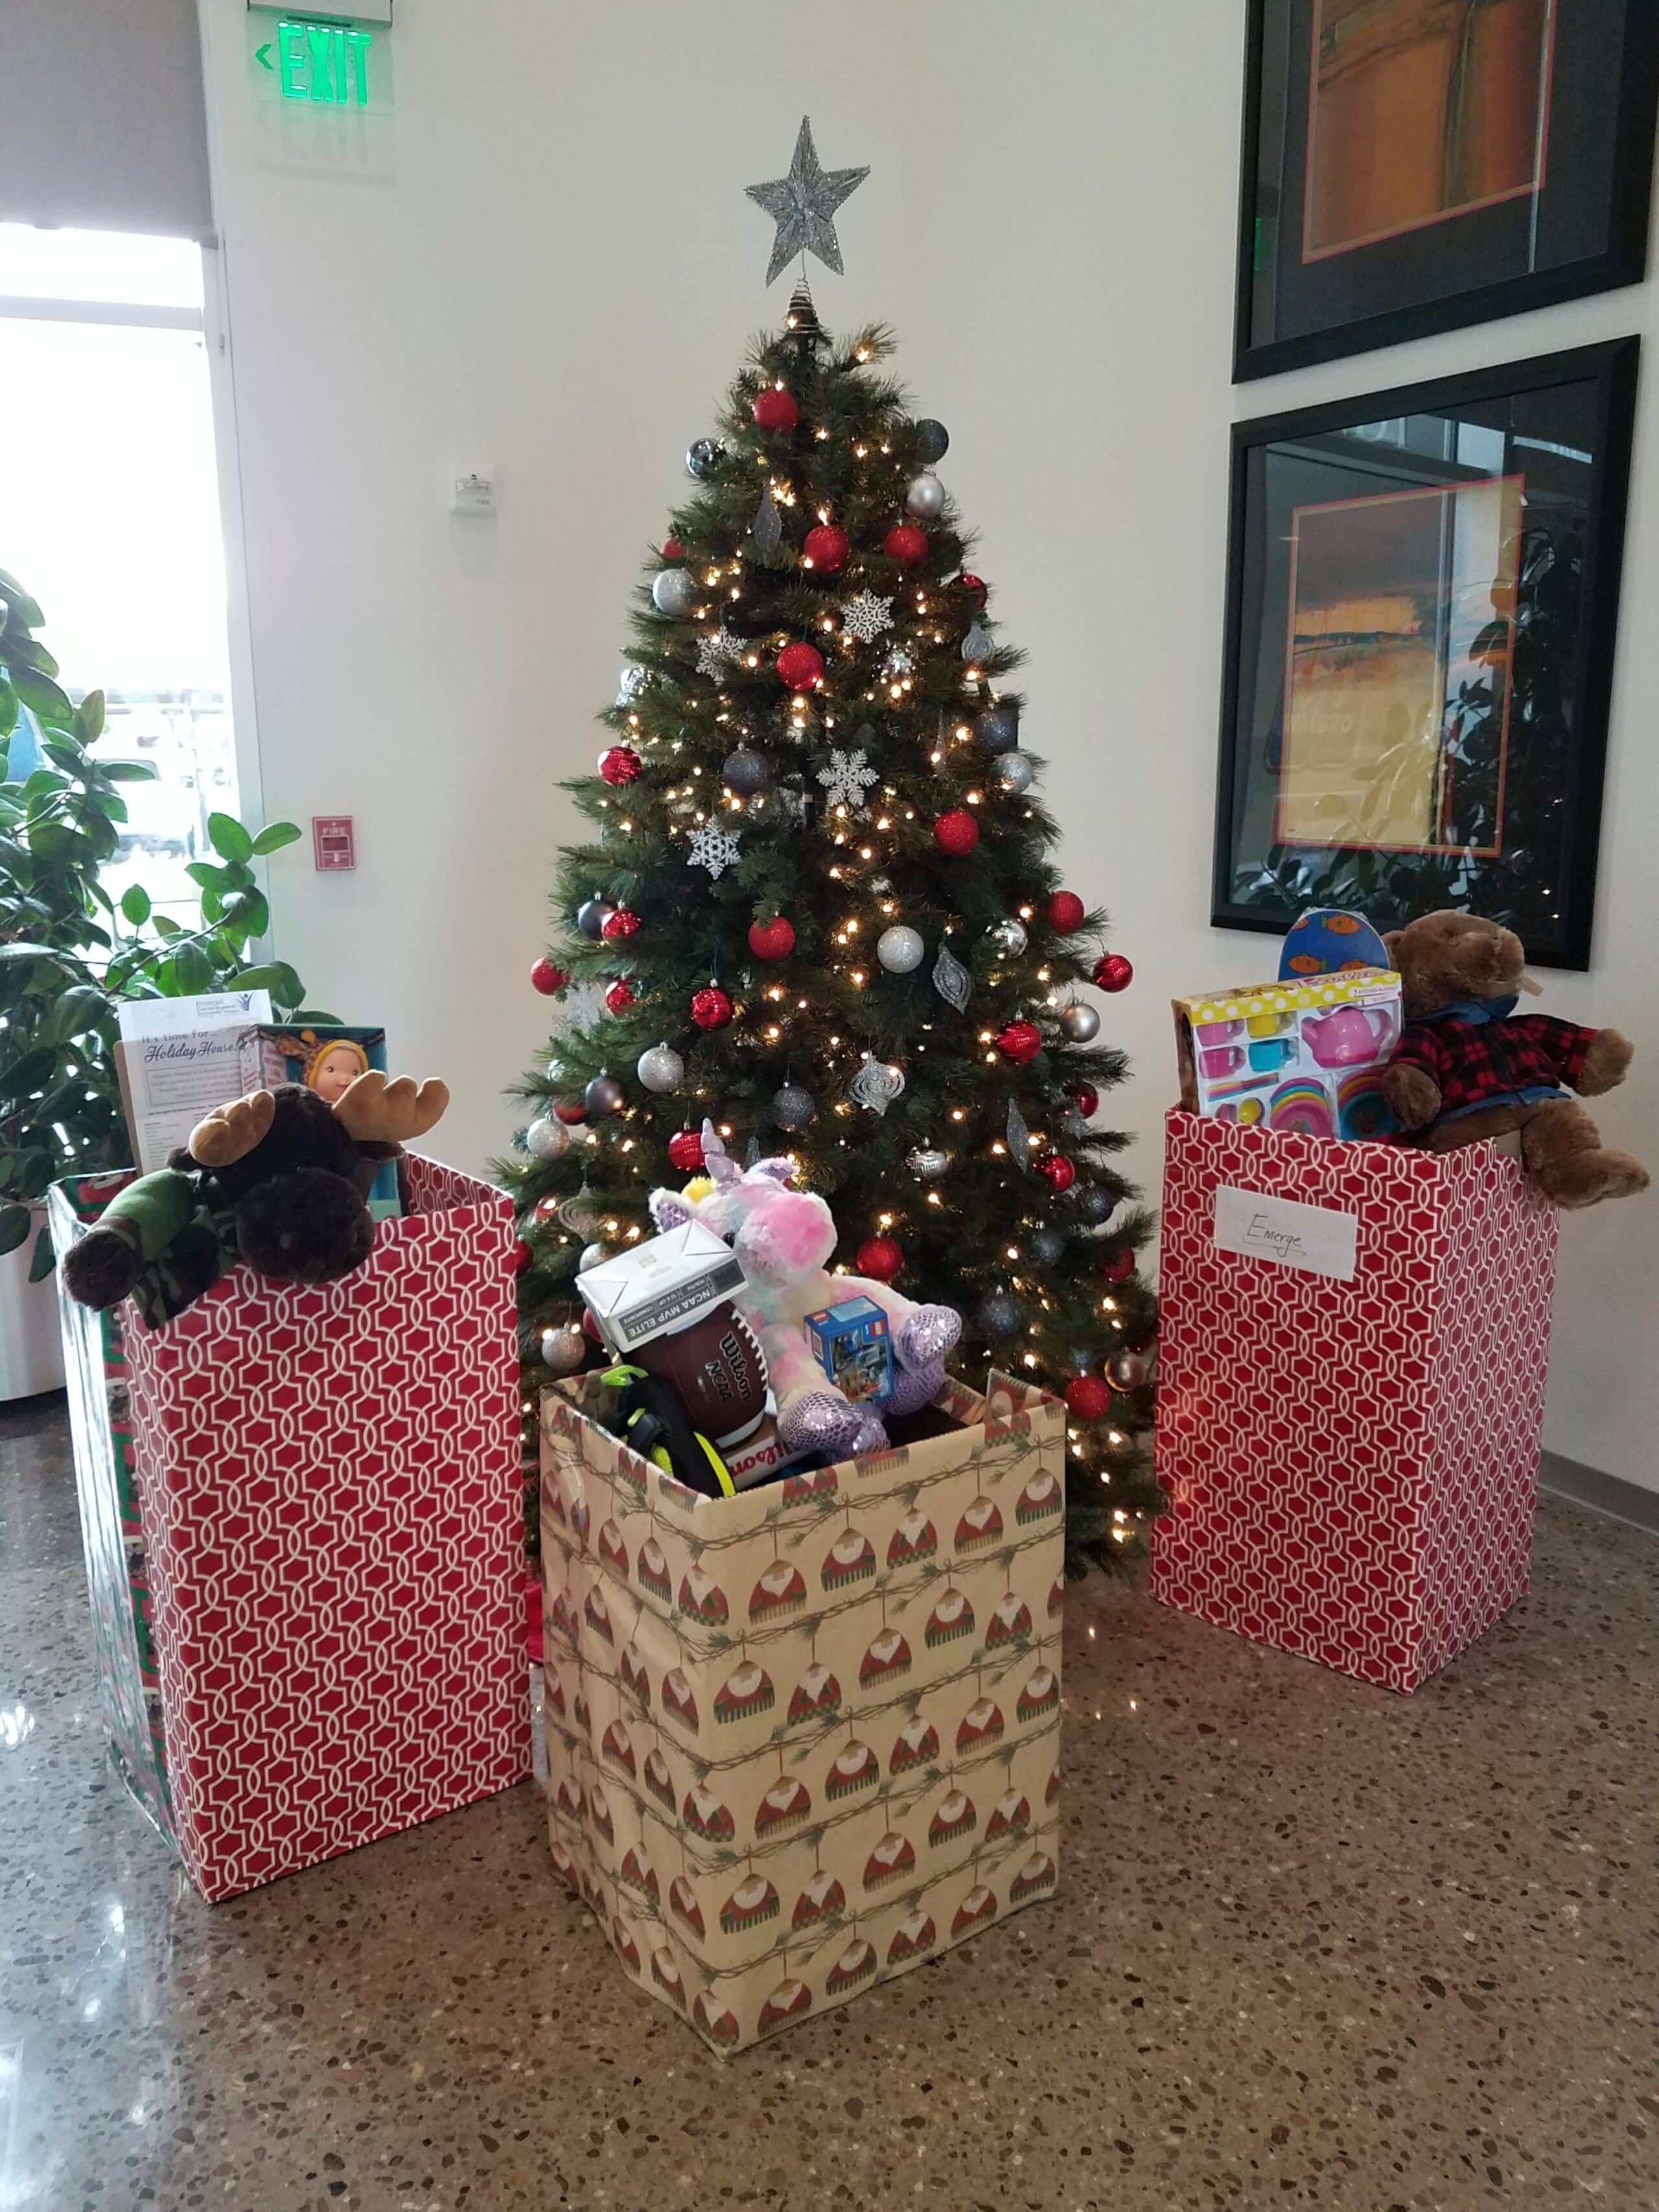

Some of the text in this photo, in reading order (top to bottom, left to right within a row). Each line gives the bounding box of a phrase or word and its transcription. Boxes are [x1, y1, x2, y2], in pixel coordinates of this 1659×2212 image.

[278, 22, 372, 106] EXIT
[323, 827, 347, 835] FIRE
[144, 1042, 196, 1063] Holiday
[1246, 1213, 1302, 1257] Emerge
[687, 1279, 705, 1291] YOUTH
[623, 1306, 653, 1324] COMPOSITE
[628, 1288, 712, 1338] NCAA MVP ELITE
[705, 1360, 734, 1401] NCAA
[719, 1331, 752, 1402] Wilson
